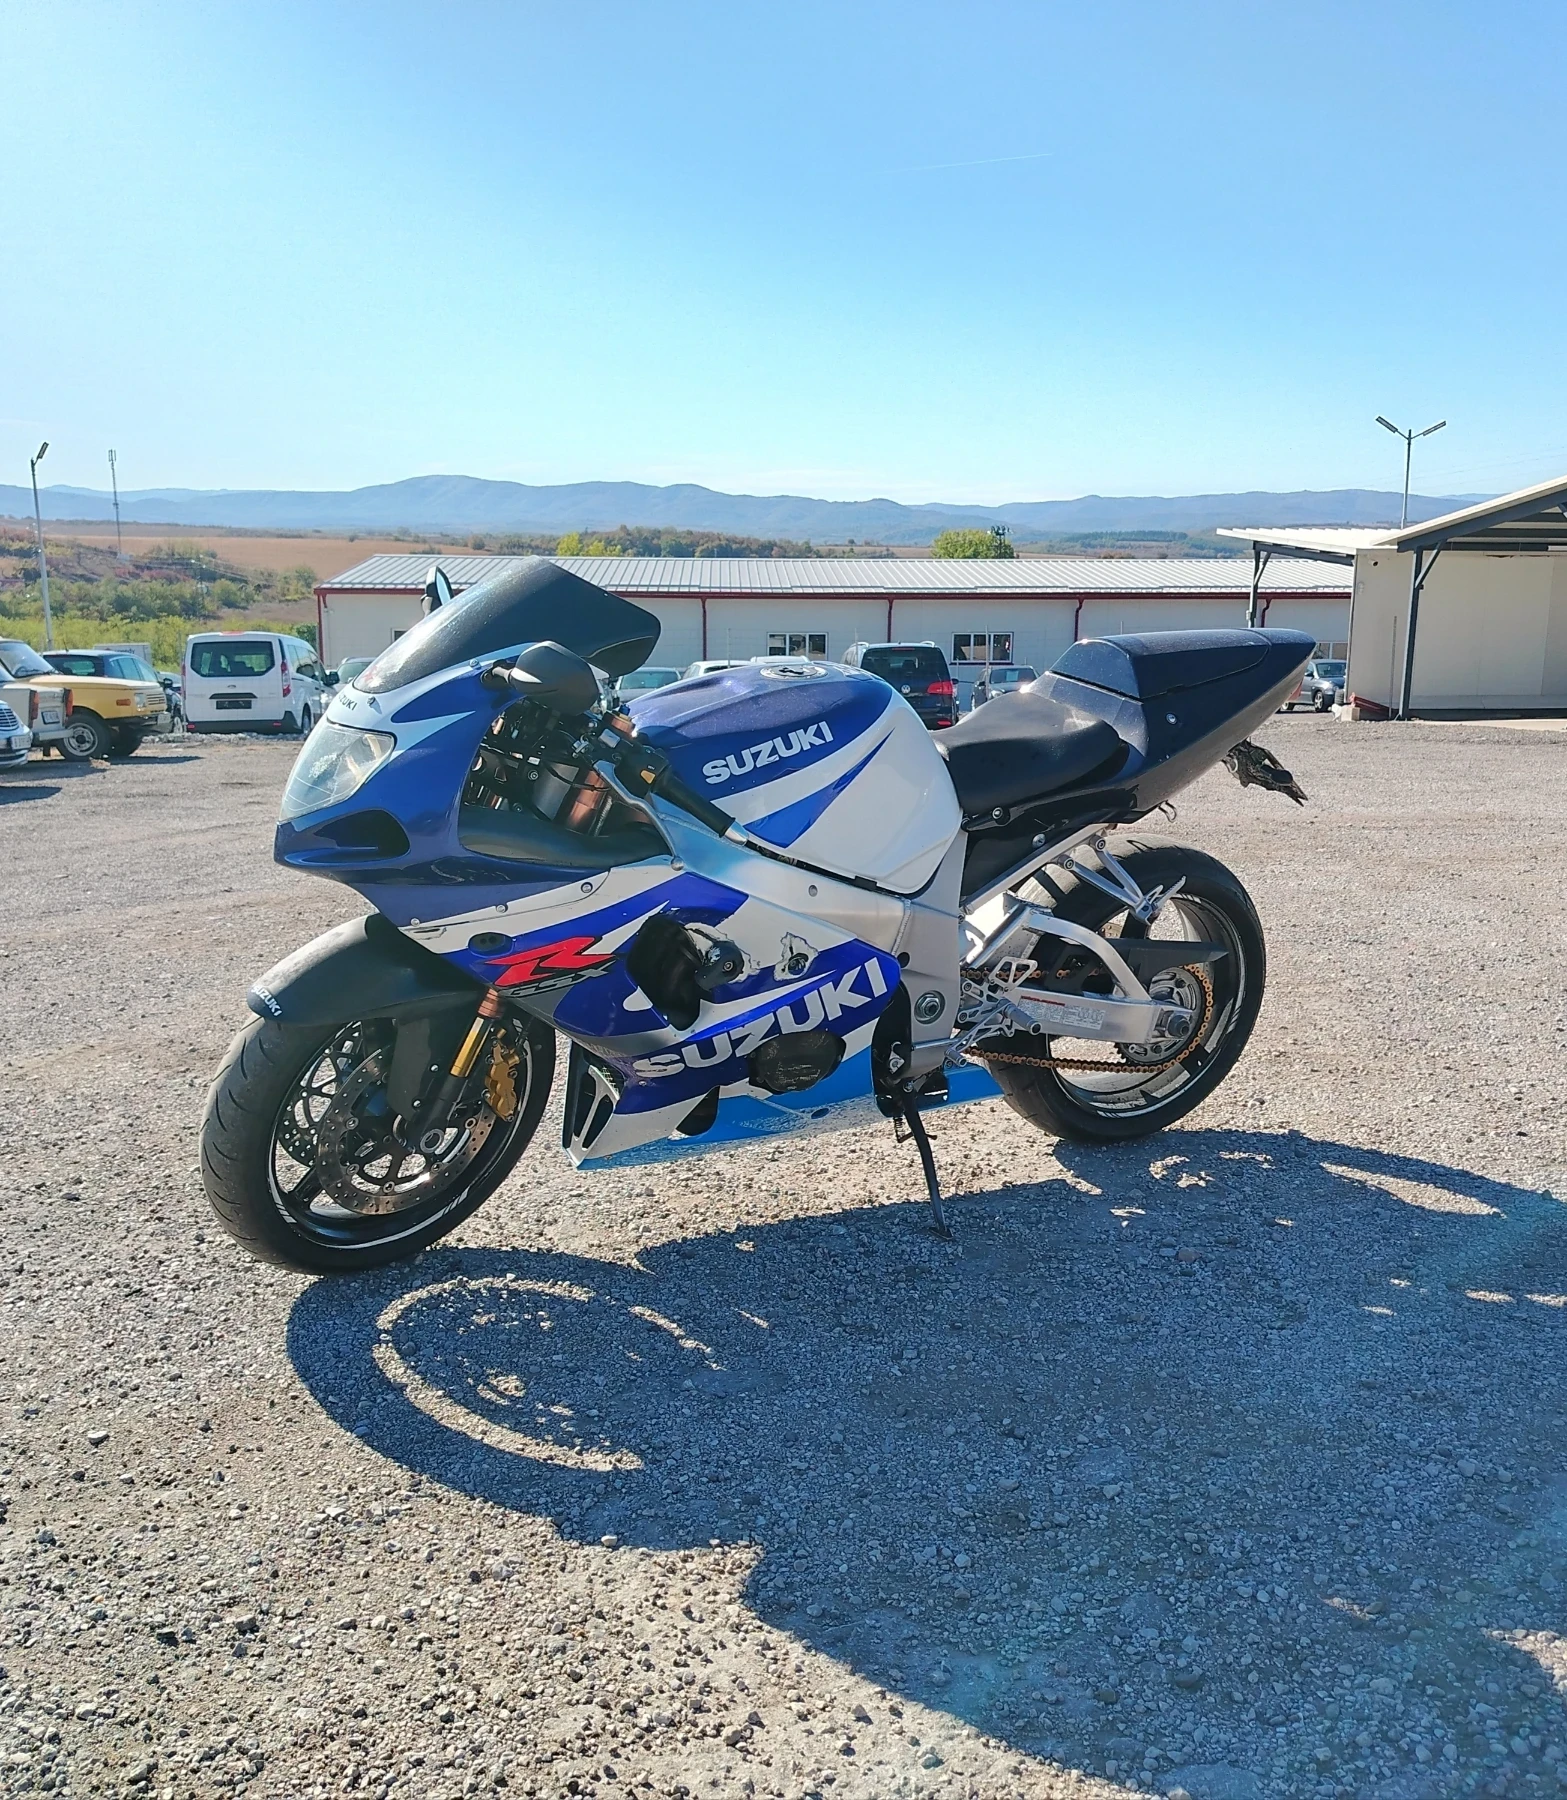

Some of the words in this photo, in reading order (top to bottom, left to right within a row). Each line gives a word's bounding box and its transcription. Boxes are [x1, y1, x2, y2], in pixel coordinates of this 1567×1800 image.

[702, 721, 834, 785] SUZUKI
[251, 985, 282, 1016] SUZUKI
[632, 957, 888, 1078] SUZUKI
